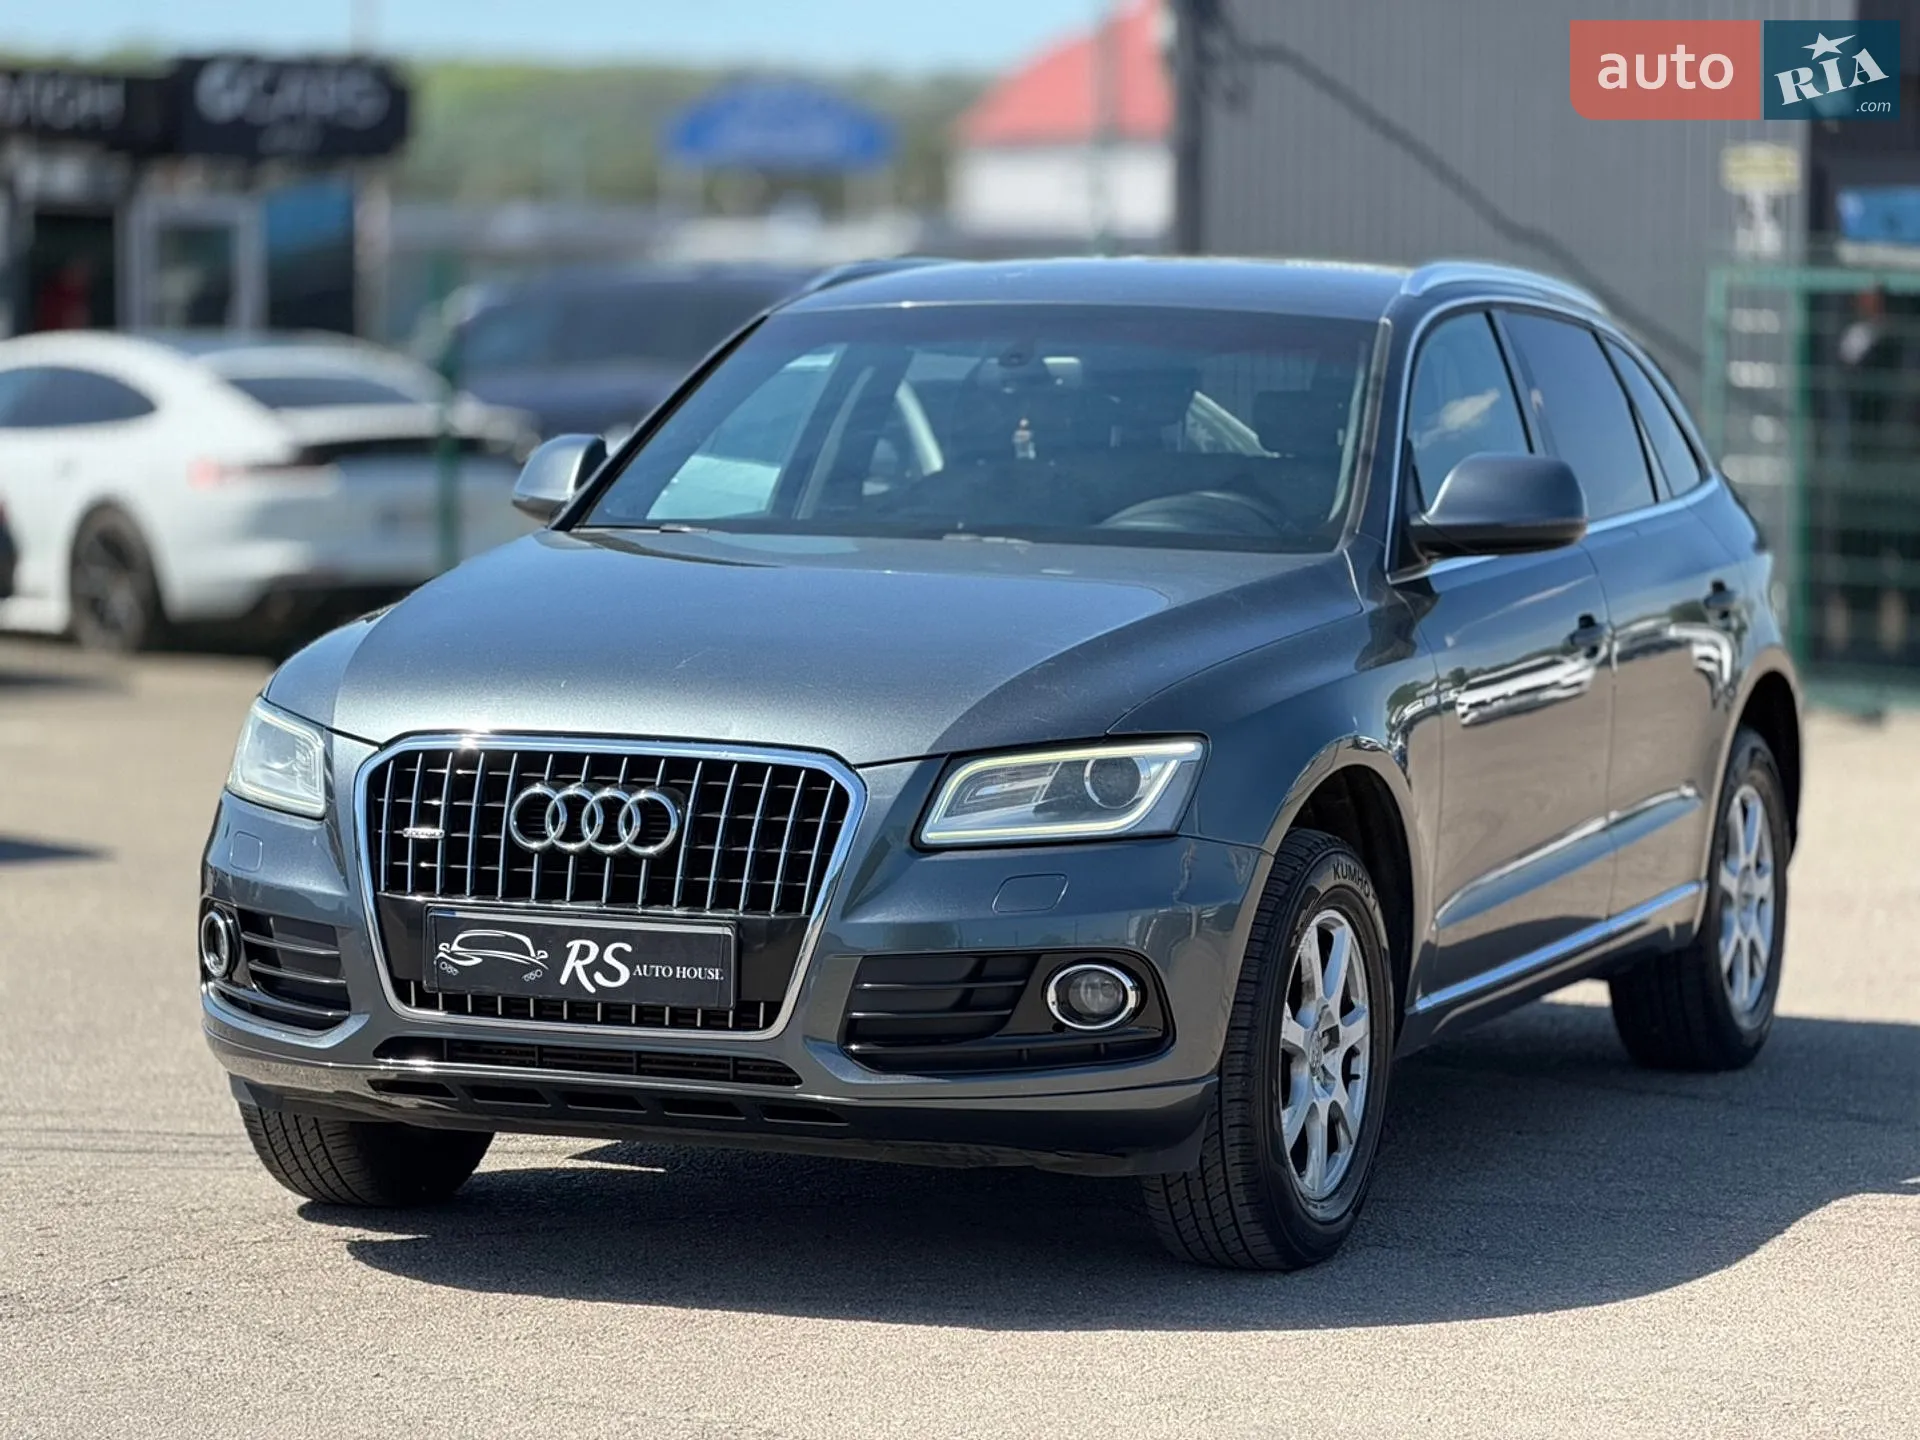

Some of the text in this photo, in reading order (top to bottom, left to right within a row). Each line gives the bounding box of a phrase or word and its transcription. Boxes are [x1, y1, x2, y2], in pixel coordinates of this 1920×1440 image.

[1332, 863, 1371, 898] KUMHO
[559, 939, 724, 994] RS AUTO HOUSE
